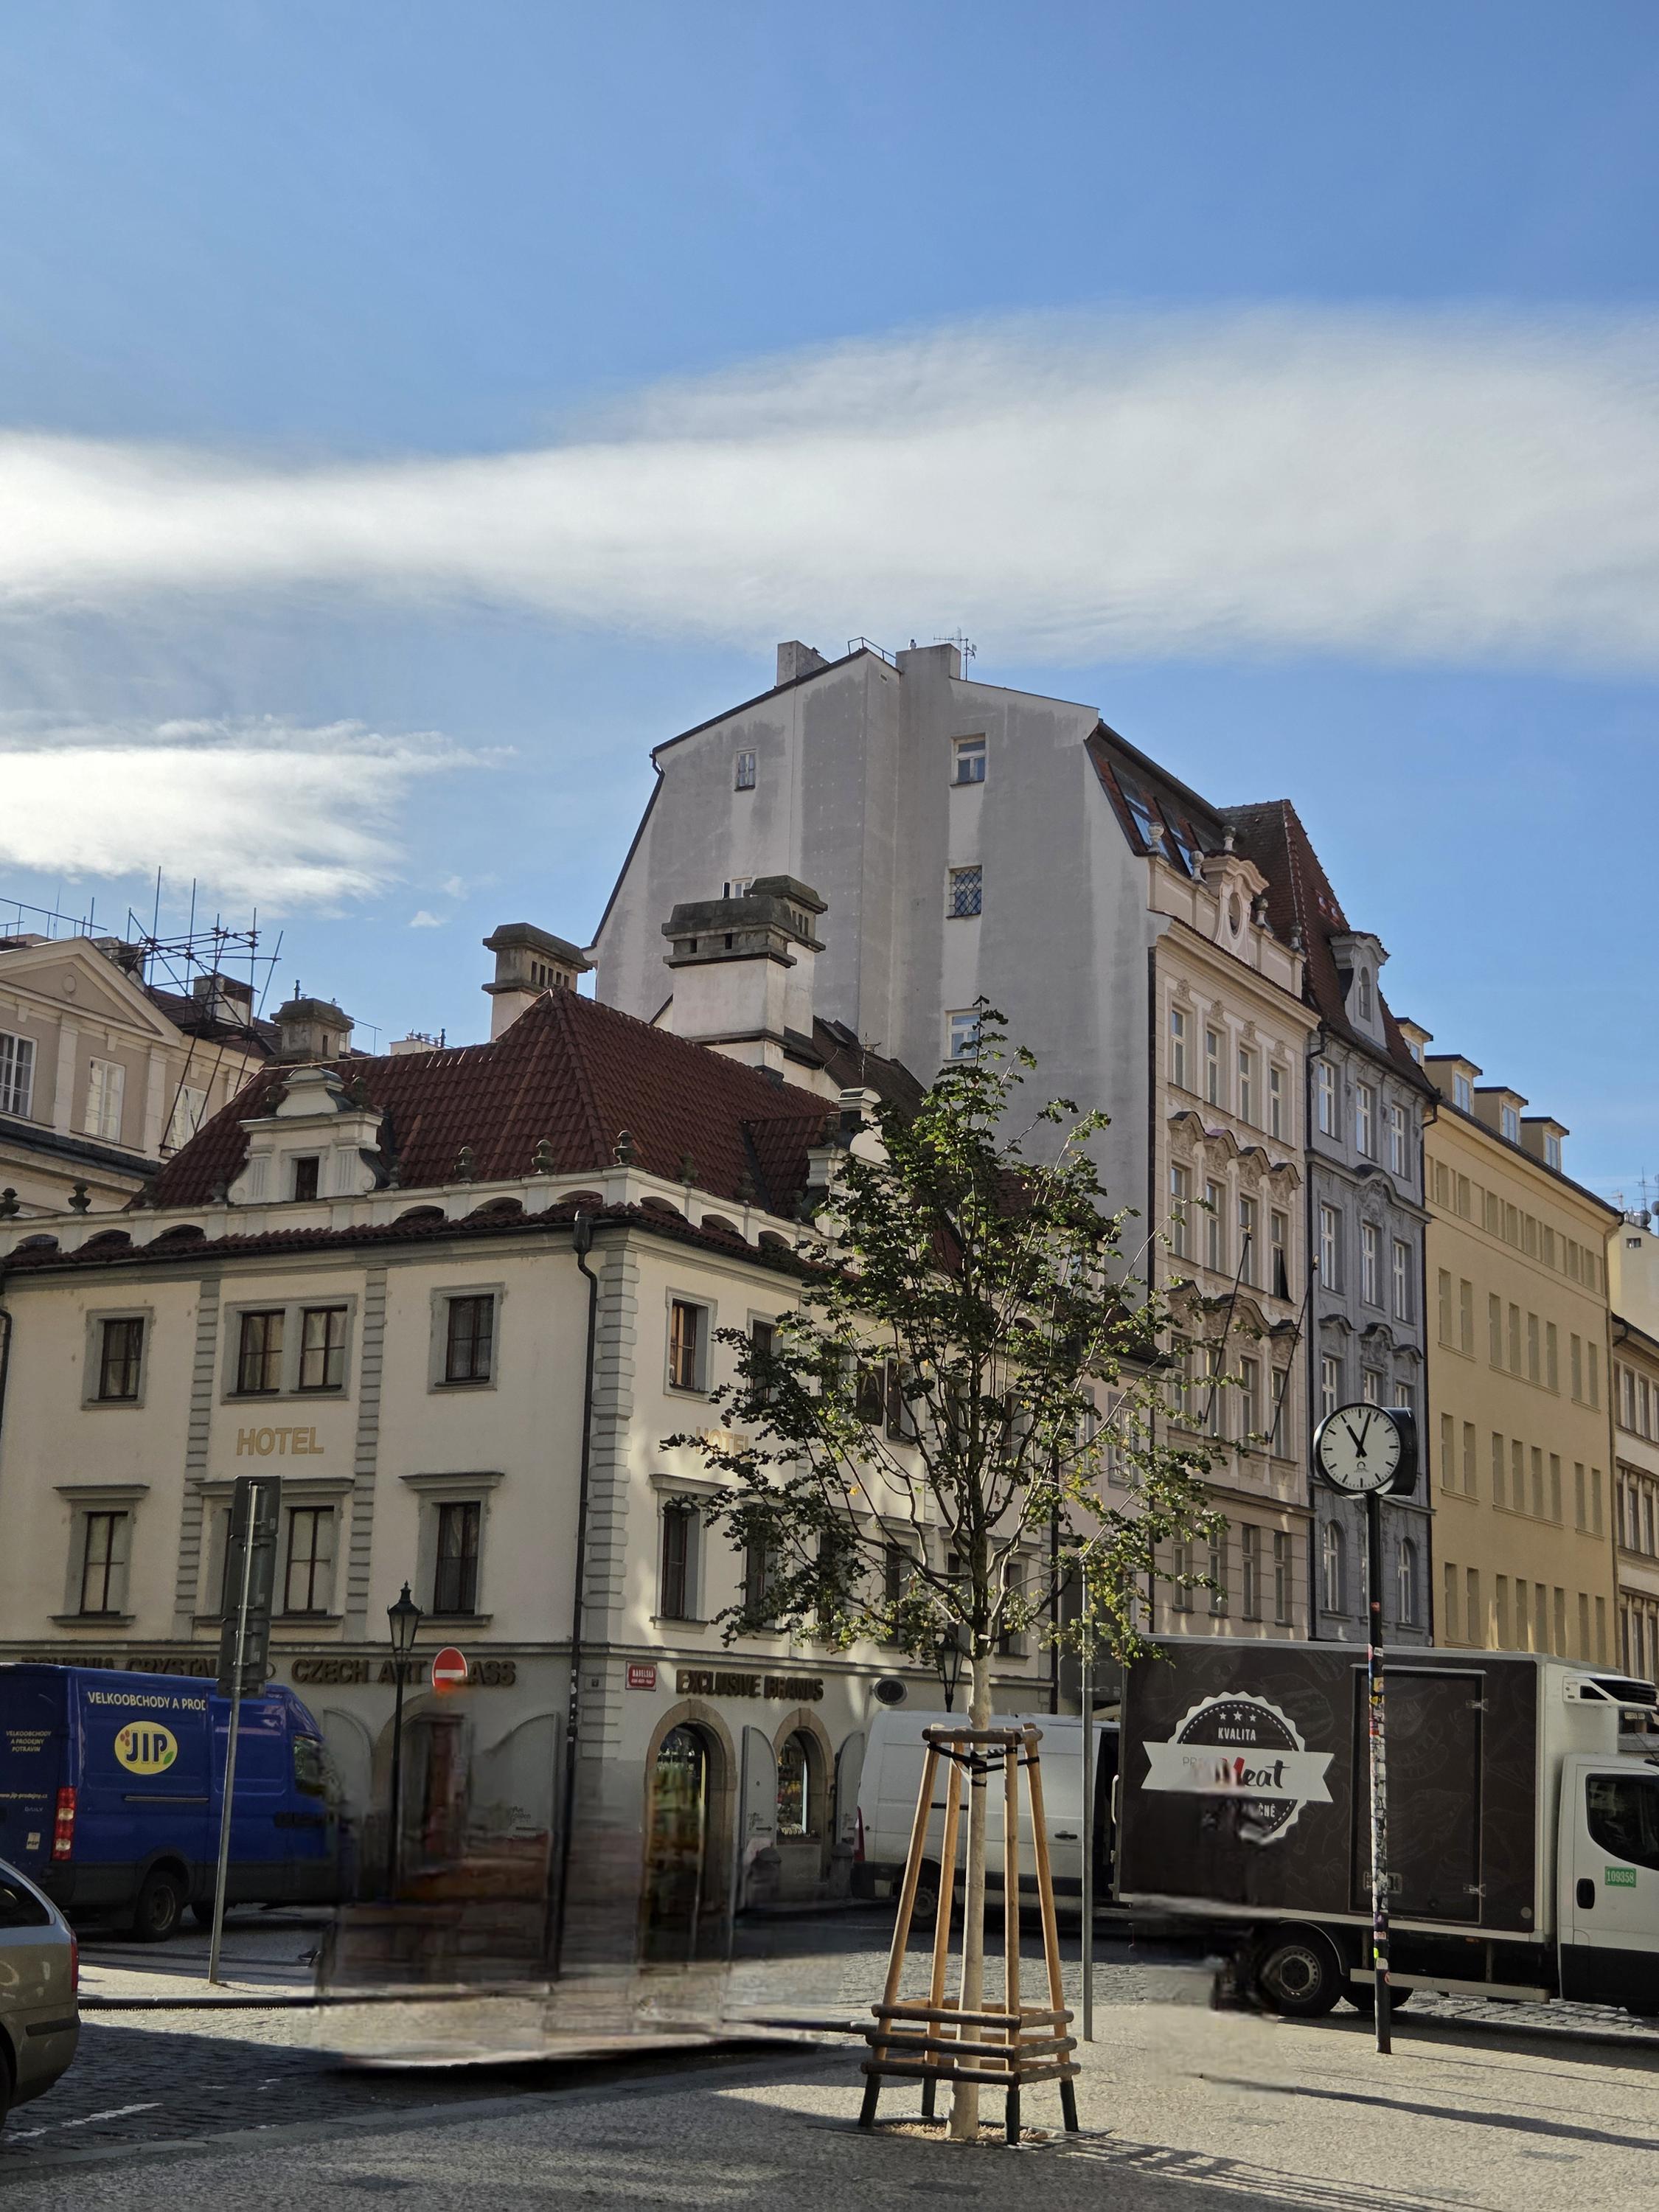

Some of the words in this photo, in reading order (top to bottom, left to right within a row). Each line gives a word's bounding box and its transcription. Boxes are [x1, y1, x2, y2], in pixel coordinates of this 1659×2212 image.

[236, 1426, 324, 1456] HOTEL
[695, 1426, 754, 1462] HOTEL
[291, 1659, 370, 1684] CZECH
[675, 1669, 762, 1698] EXCLUSIVE
[764, 1675, 824, 1702] BRANDS
[88, 1691, 170, 1709] VELKOOBCHODY
[172, 1697, 180, 1710] A
[125, 1731, 168, 1762] JIP
[1217, 1727, 1256, 1741] KVALITA
[1607, 1870, 1634, 1883] 109358
